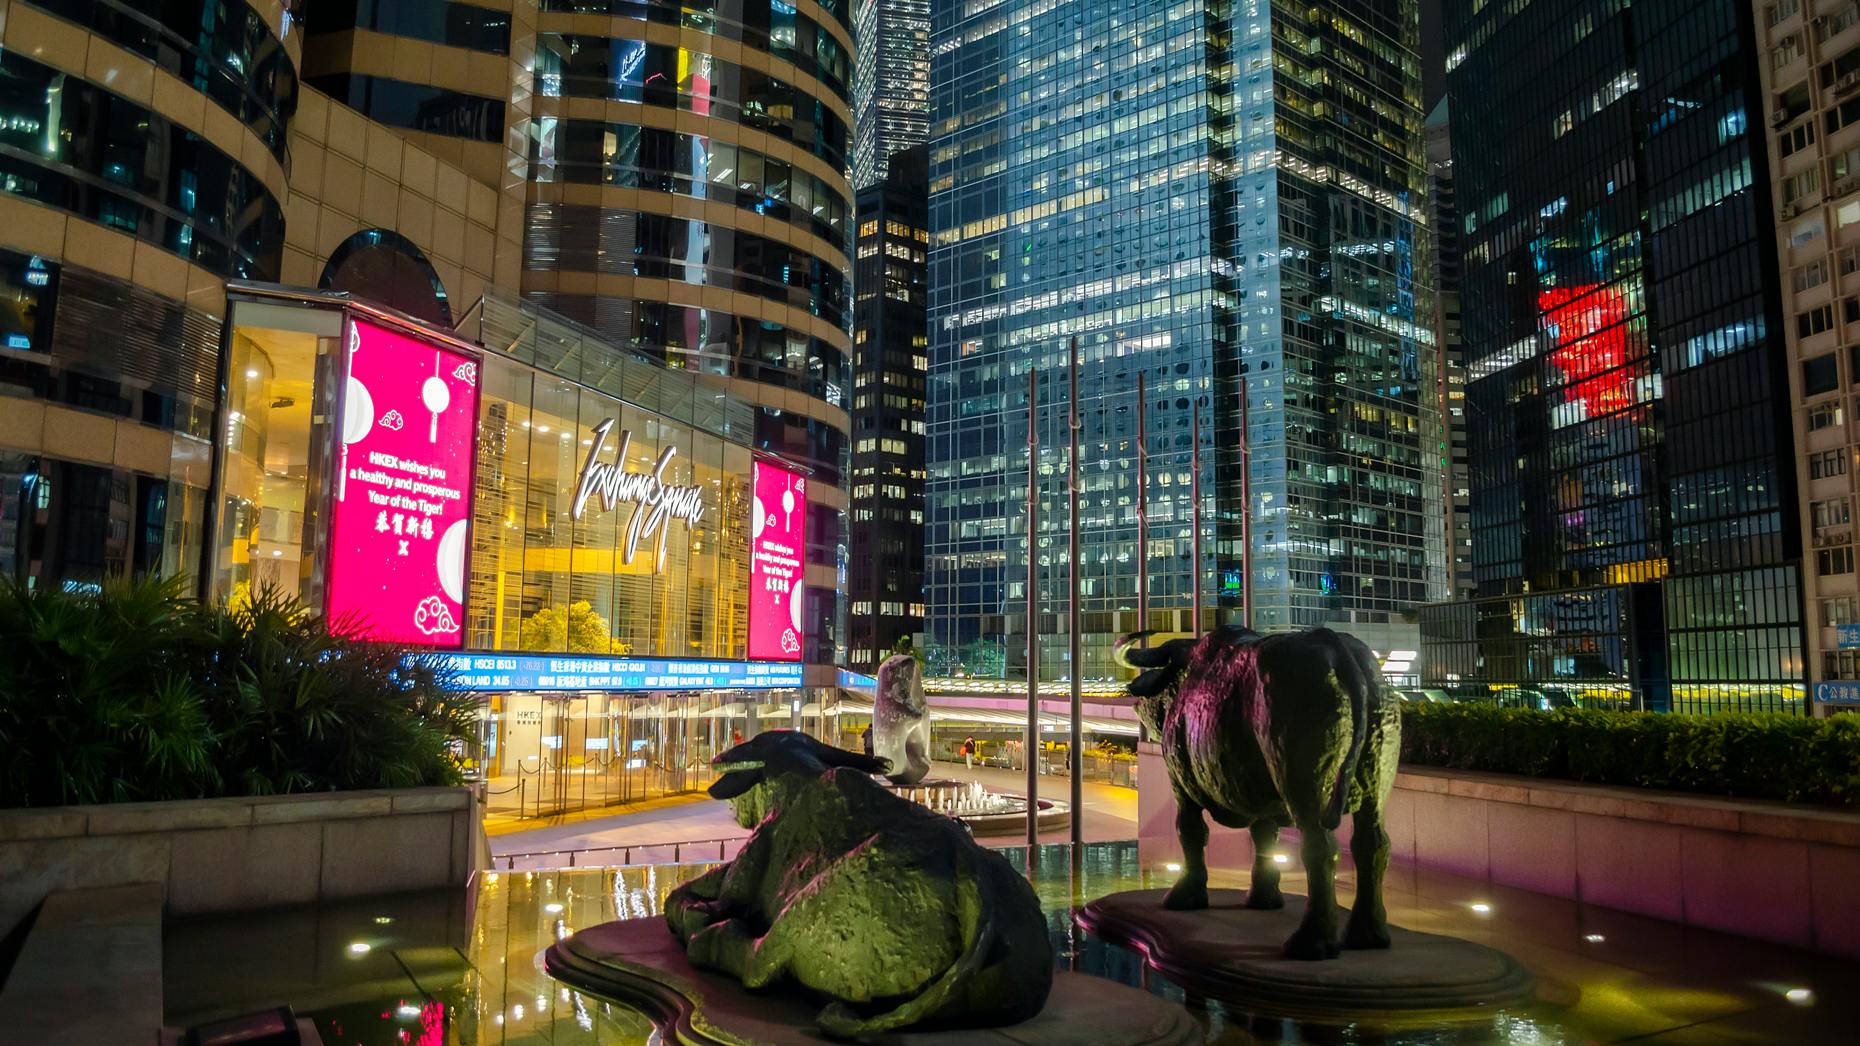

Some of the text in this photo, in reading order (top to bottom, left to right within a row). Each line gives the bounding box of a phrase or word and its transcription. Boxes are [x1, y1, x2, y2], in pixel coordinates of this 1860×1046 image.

[369, 450, 446, 480] HKEX wishes you
[349, 467, 461, 500] a healthy and prosperous
[571, 417, 704, 574] Exchange Square
[368, 489, 443, 517] Year of the Tiger!
[474, 659, 495, 670] HSCEI
